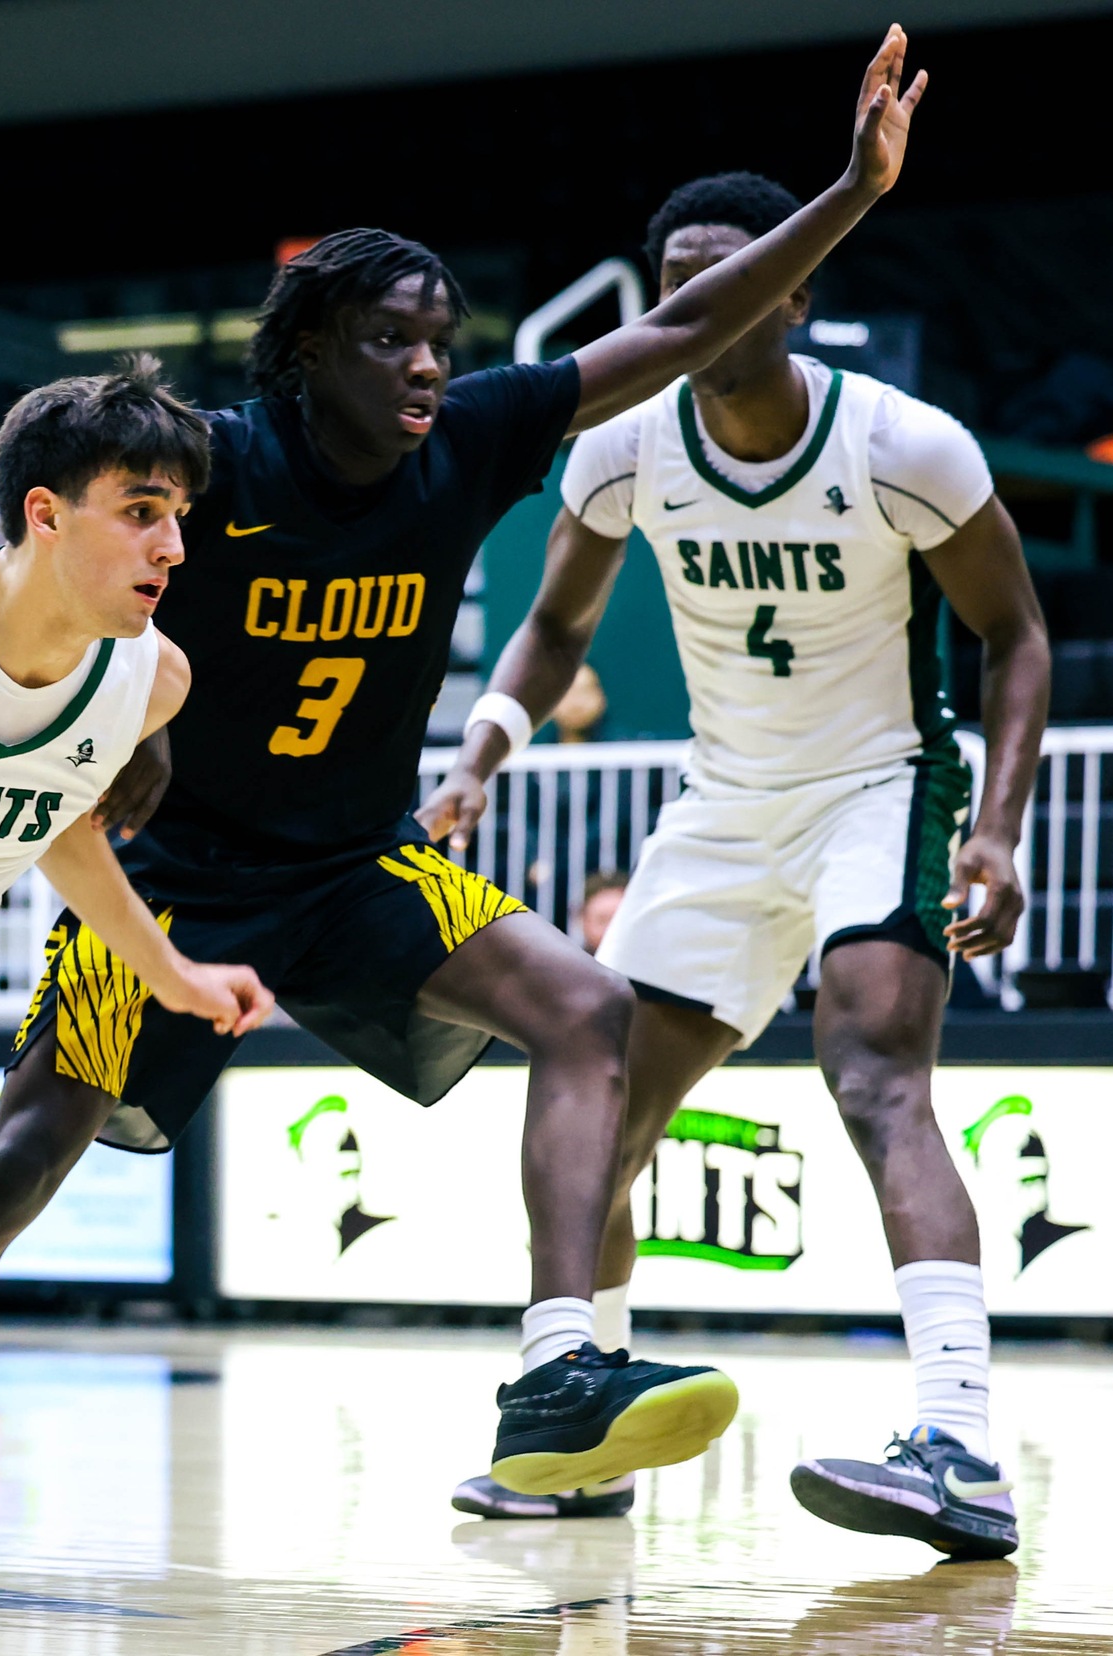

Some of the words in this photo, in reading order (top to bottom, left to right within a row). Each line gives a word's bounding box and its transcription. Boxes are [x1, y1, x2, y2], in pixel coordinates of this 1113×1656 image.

[677, 539, 845, 591] SAINTS
[245, 573, 426, 642] CLOUD
[747, 605, 795, 677] 4
[268, 657, 366, 757] 3
